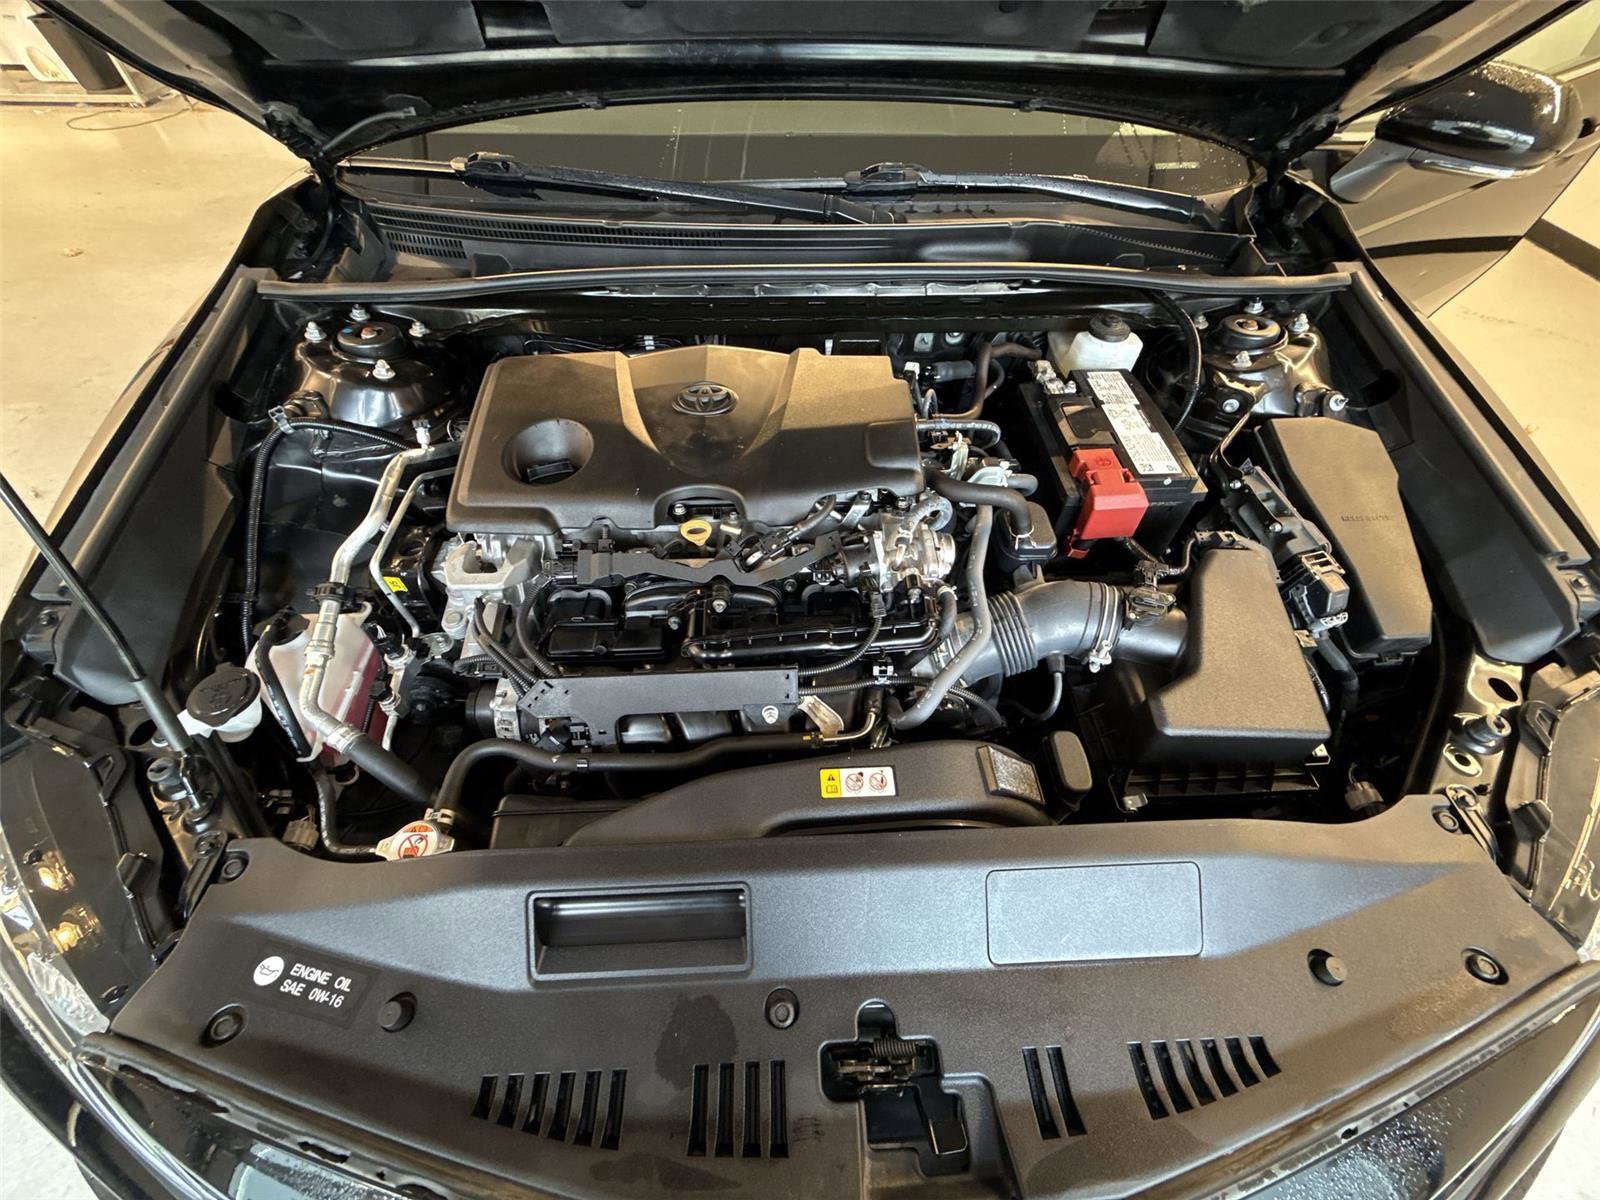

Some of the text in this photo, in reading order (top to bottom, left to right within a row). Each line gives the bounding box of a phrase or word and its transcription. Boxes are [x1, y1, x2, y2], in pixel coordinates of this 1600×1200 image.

[289, 963, 352, 992] ENGINE OIL
[279, 979, 345, 1008] SAE 0W-16
